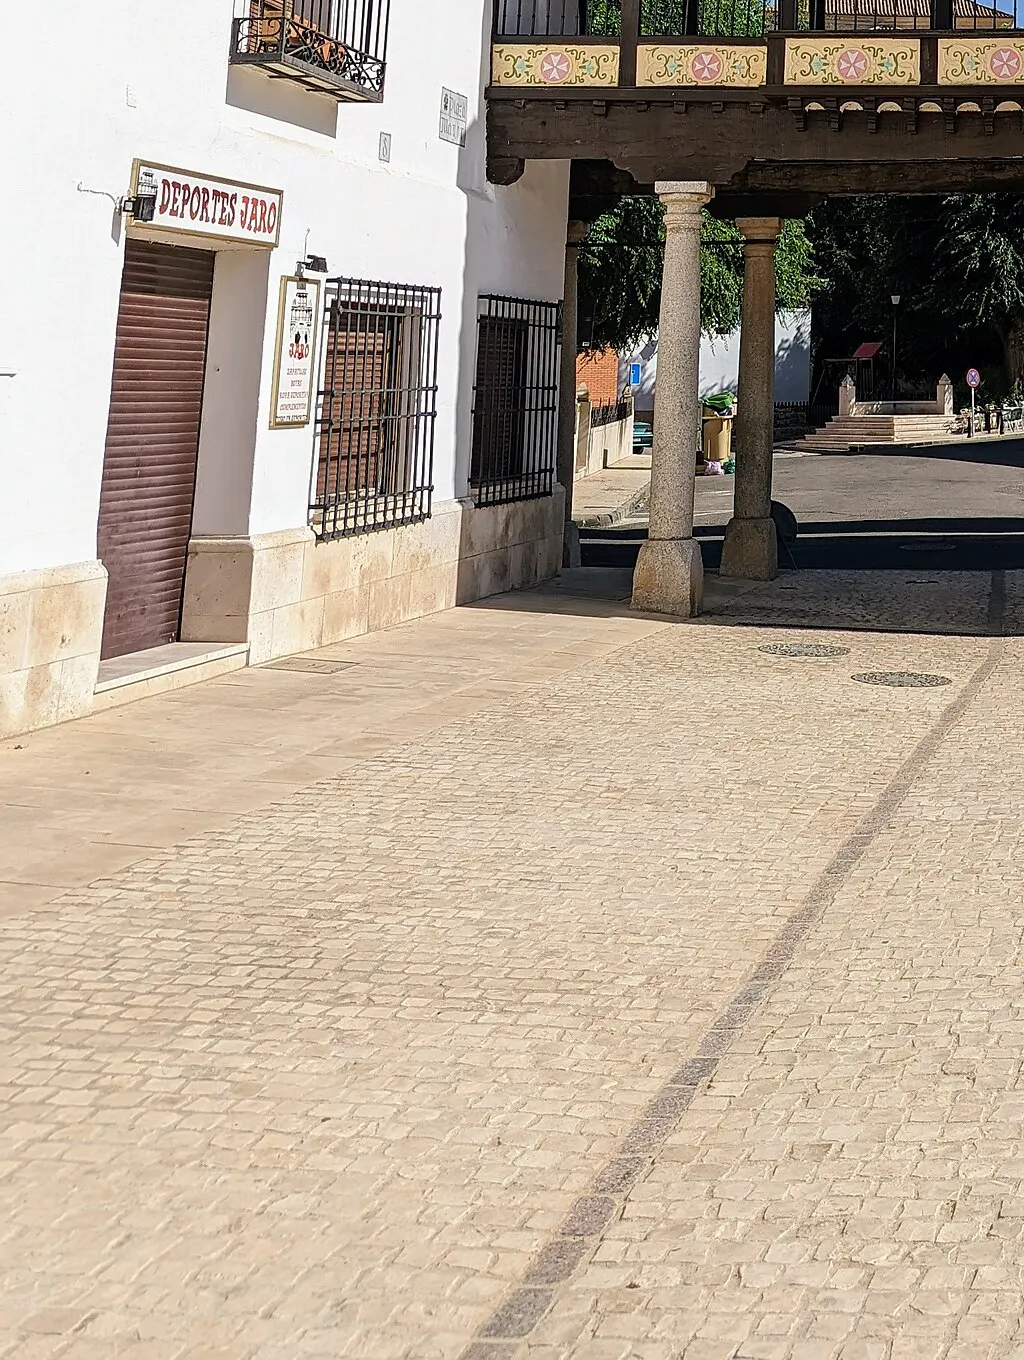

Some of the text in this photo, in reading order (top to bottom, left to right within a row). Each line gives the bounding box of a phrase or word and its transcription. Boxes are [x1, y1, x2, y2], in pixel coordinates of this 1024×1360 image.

[159, 179, 277, 234] DEPORTES JARO
[289, 343, 310, 360] JARO
